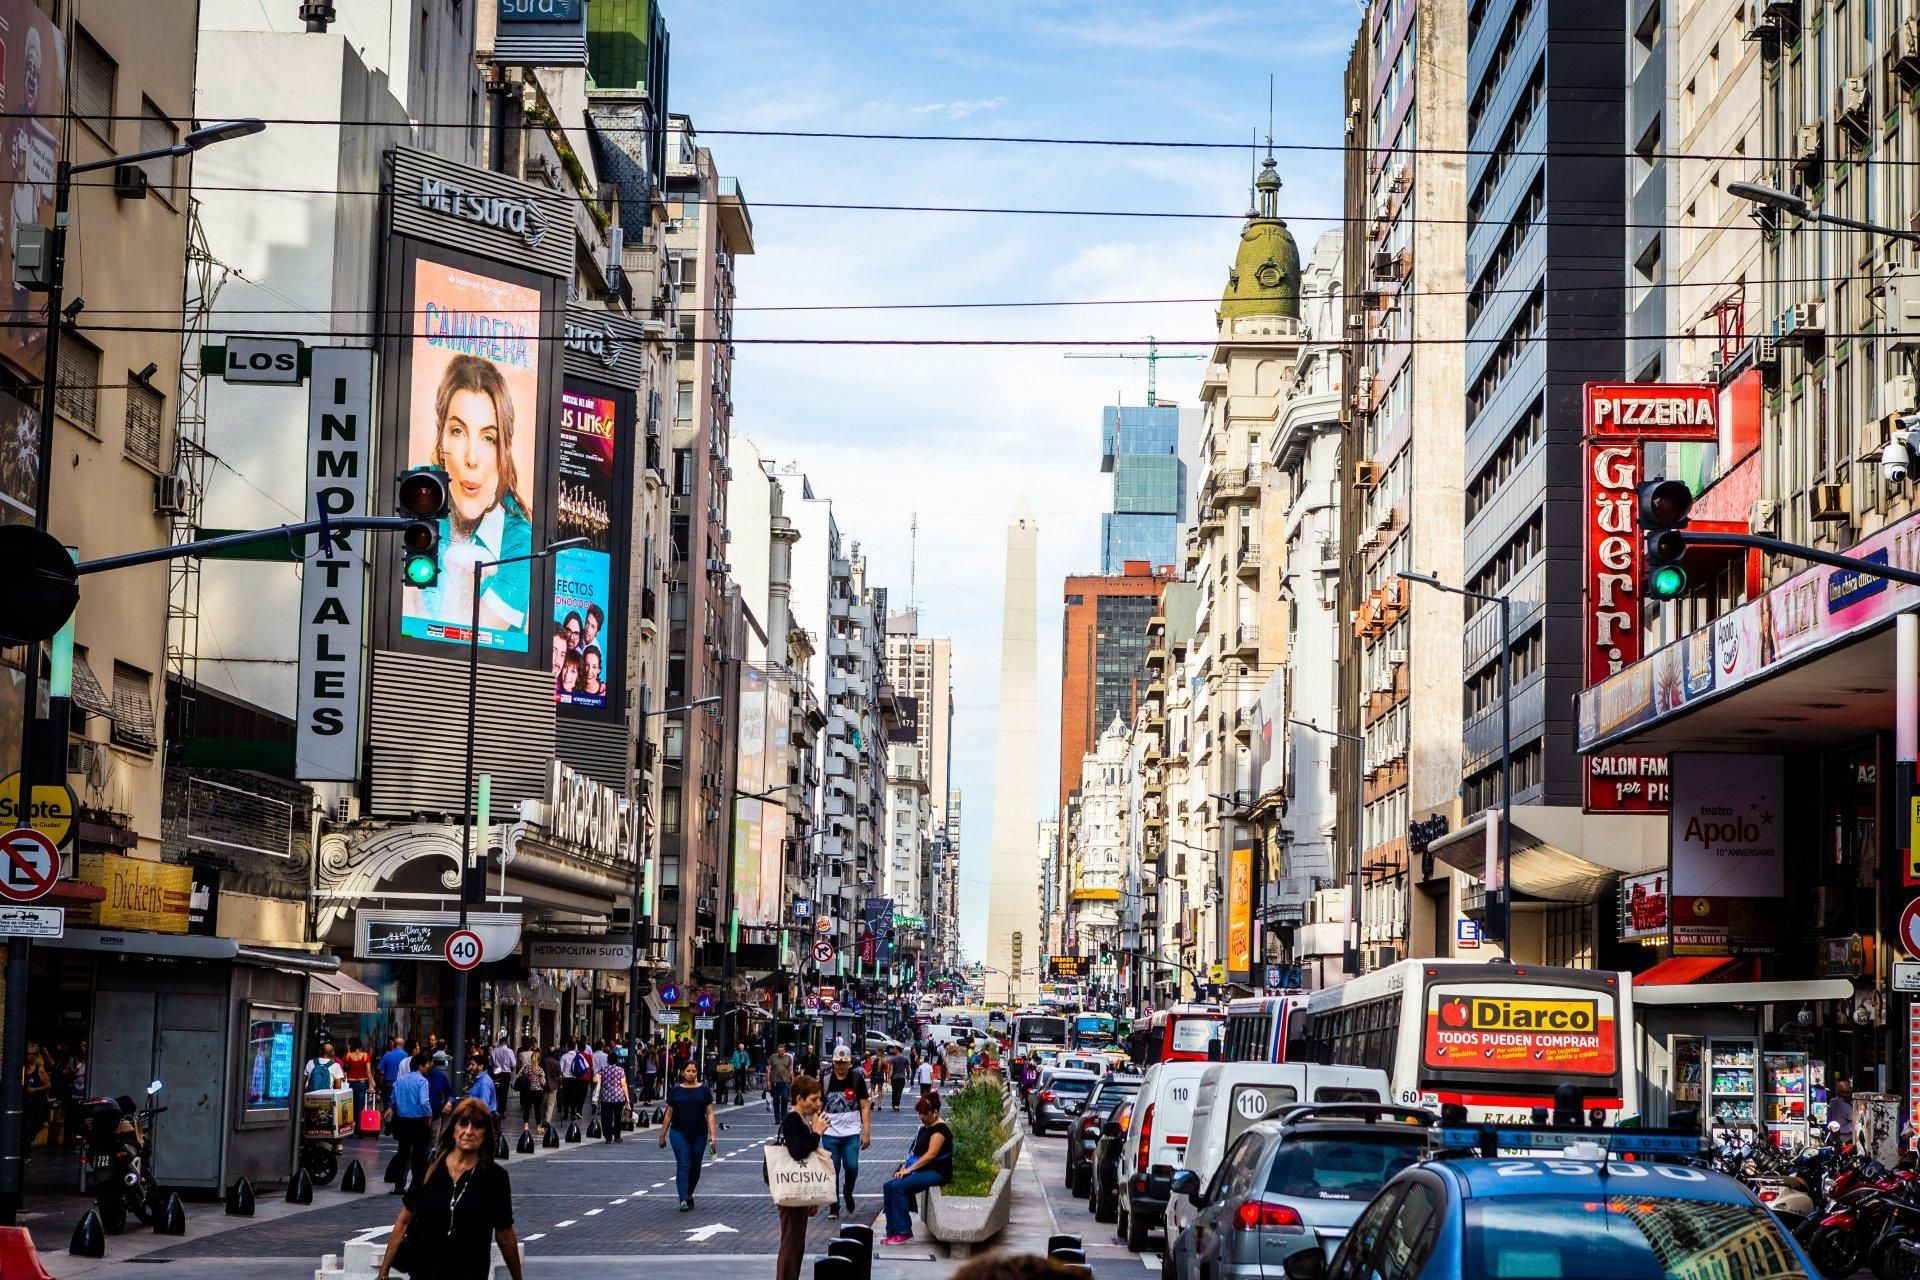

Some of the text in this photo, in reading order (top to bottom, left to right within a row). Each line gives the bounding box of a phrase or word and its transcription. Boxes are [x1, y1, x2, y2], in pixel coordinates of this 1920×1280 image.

[421, 177, 526, 235] MET sura
[425, 302, 528, 368] CAMARERA
[229, 352, 295, 370] LOS
[1594, 398, 1714, 425] PIZZERIA
[311, 377, 358, 736] INMORTALES
[557, 579, 594, 597] FECTOS
[1592, 757, 1668, 776] SALON FAM
[1700, 805, 1733, 816] teatro
[1684, 815, 1760, 849] Apolo
[112, 865, 164, 914] Dickens
[1462, 922, 1476, 939] E
[453, 942, 476, 958] 40
[534, 945, 624, 956] METROPOLITAN sura
[1477, 1002, 1590, 1029] Diarco
[1437, 1032, 1600, 1048] TODOS PUEDEN COMPRAR!
[1173, 1087, 1189, 1101] 110
[1402, 1090, 1417, 1104] 60
[1240, 1094, 1265, 1114] 110
[1488, 1160, 1708, 1182] 2500
